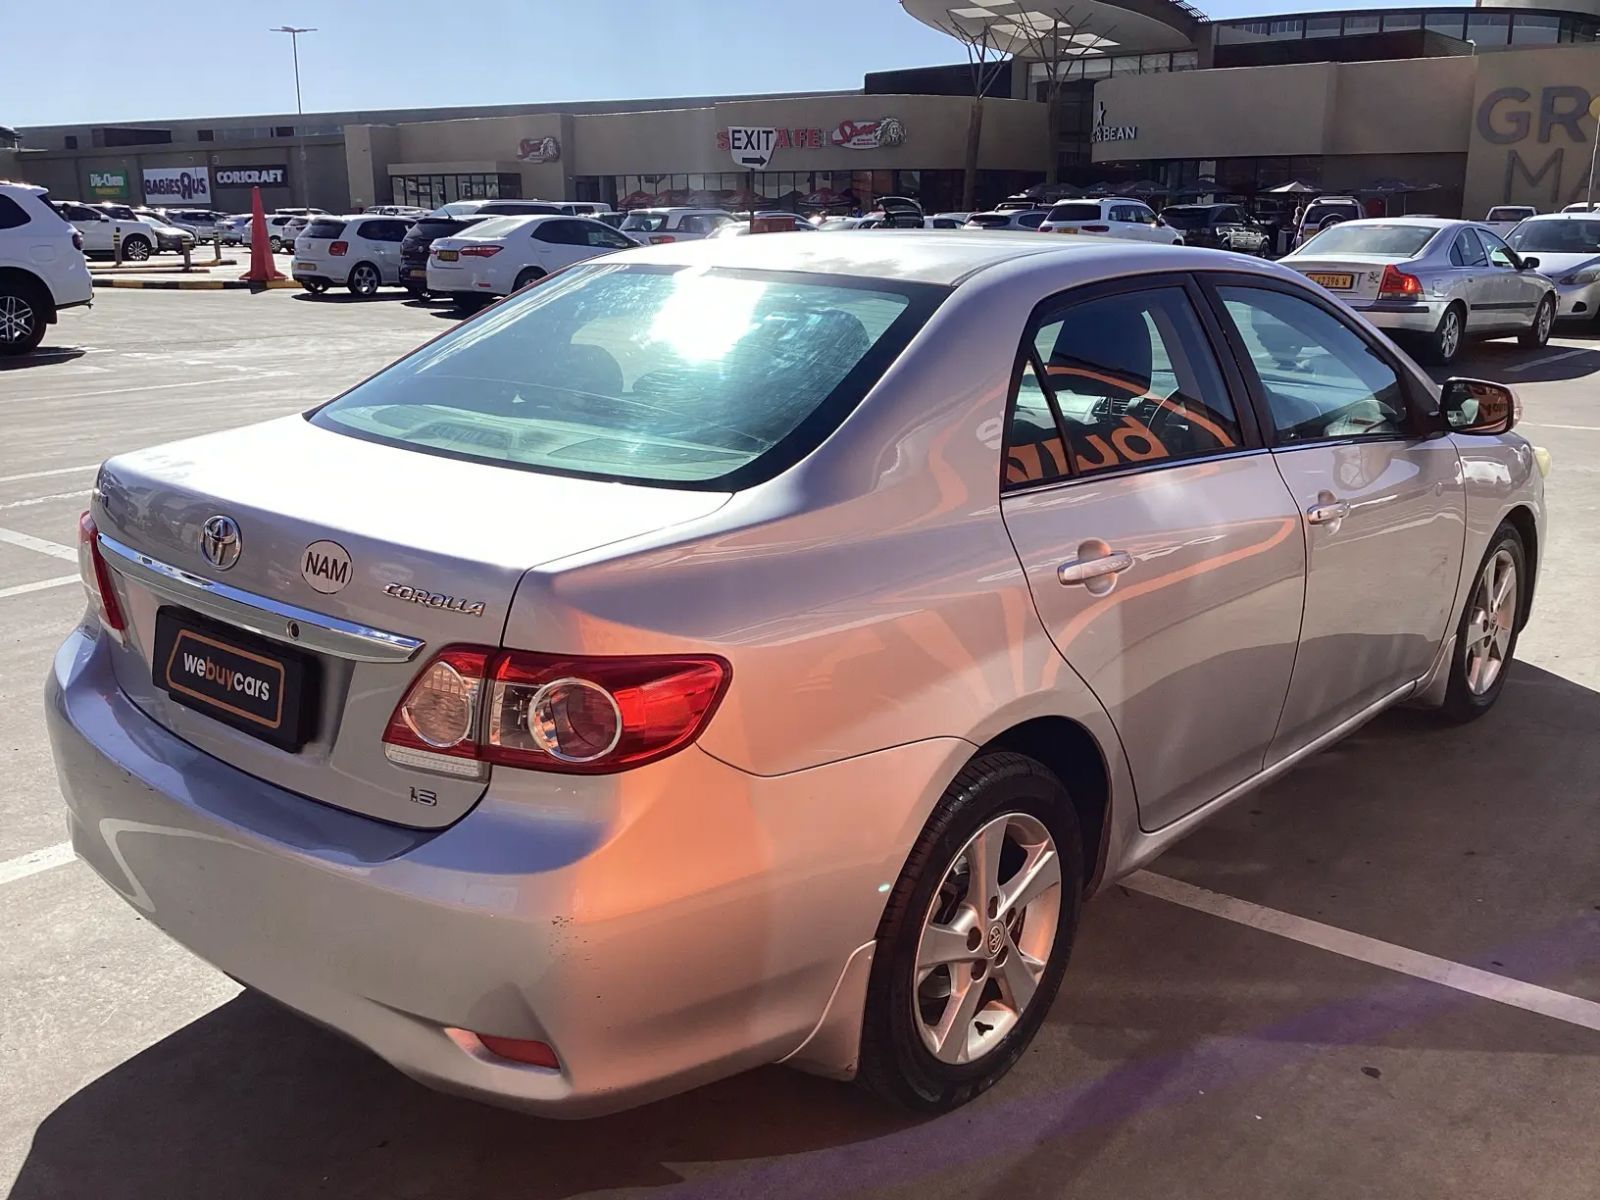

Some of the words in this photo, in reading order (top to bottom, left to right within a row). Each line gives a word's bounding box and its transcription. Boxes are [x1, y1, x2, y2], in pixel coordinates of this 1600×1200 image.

[731, 129, 774, 150] EXIT
[1103, 126, 1137, 141] BEAN
[216, 169, 284, 183] CORICRAFT
[305, 551, 349, 584] NAM
[382, 581, 487, 618] COROLLA
[183, 652, 270, 702] webuycars
